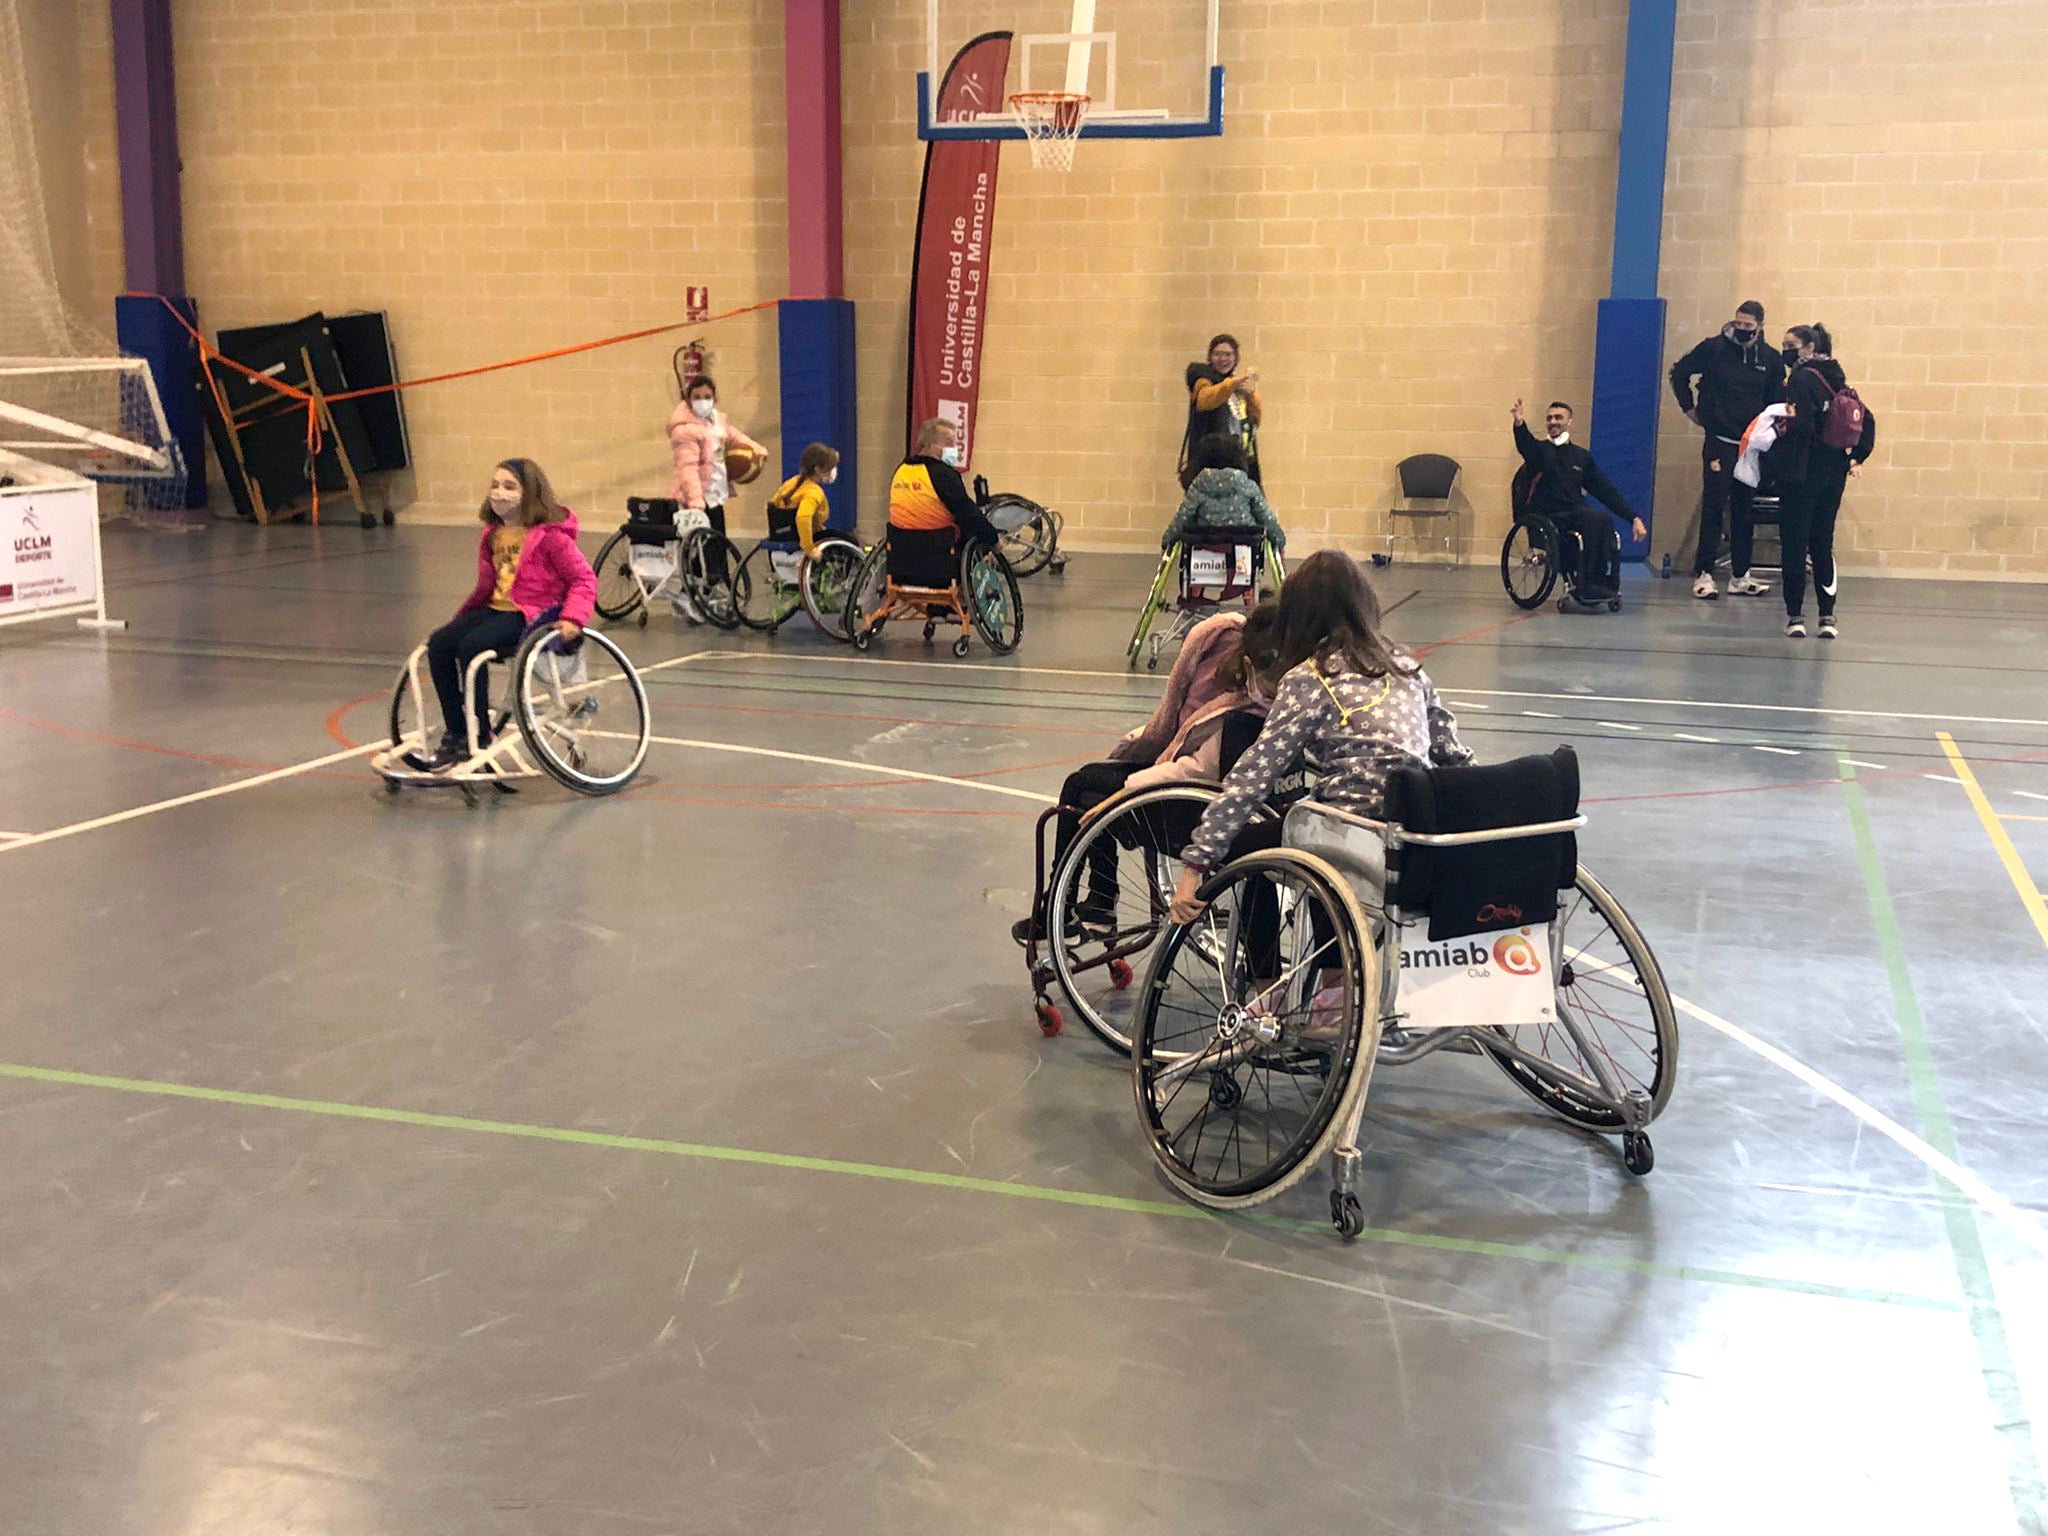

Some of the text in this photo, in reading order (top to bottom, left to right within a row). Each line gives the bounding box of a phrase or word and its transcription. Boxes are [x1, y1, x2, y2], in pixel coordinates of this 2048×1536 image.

[957, 172, 988, 388] Castilla-La Mancha
[940, 216, 967, 385] Universidad de
[956, 406, 966, 453] UCLM
[14, 535, 52, 551] UCLM
[1400, 942, 1489, 968] amiab
[1467, 968, 1491, 978] Club
